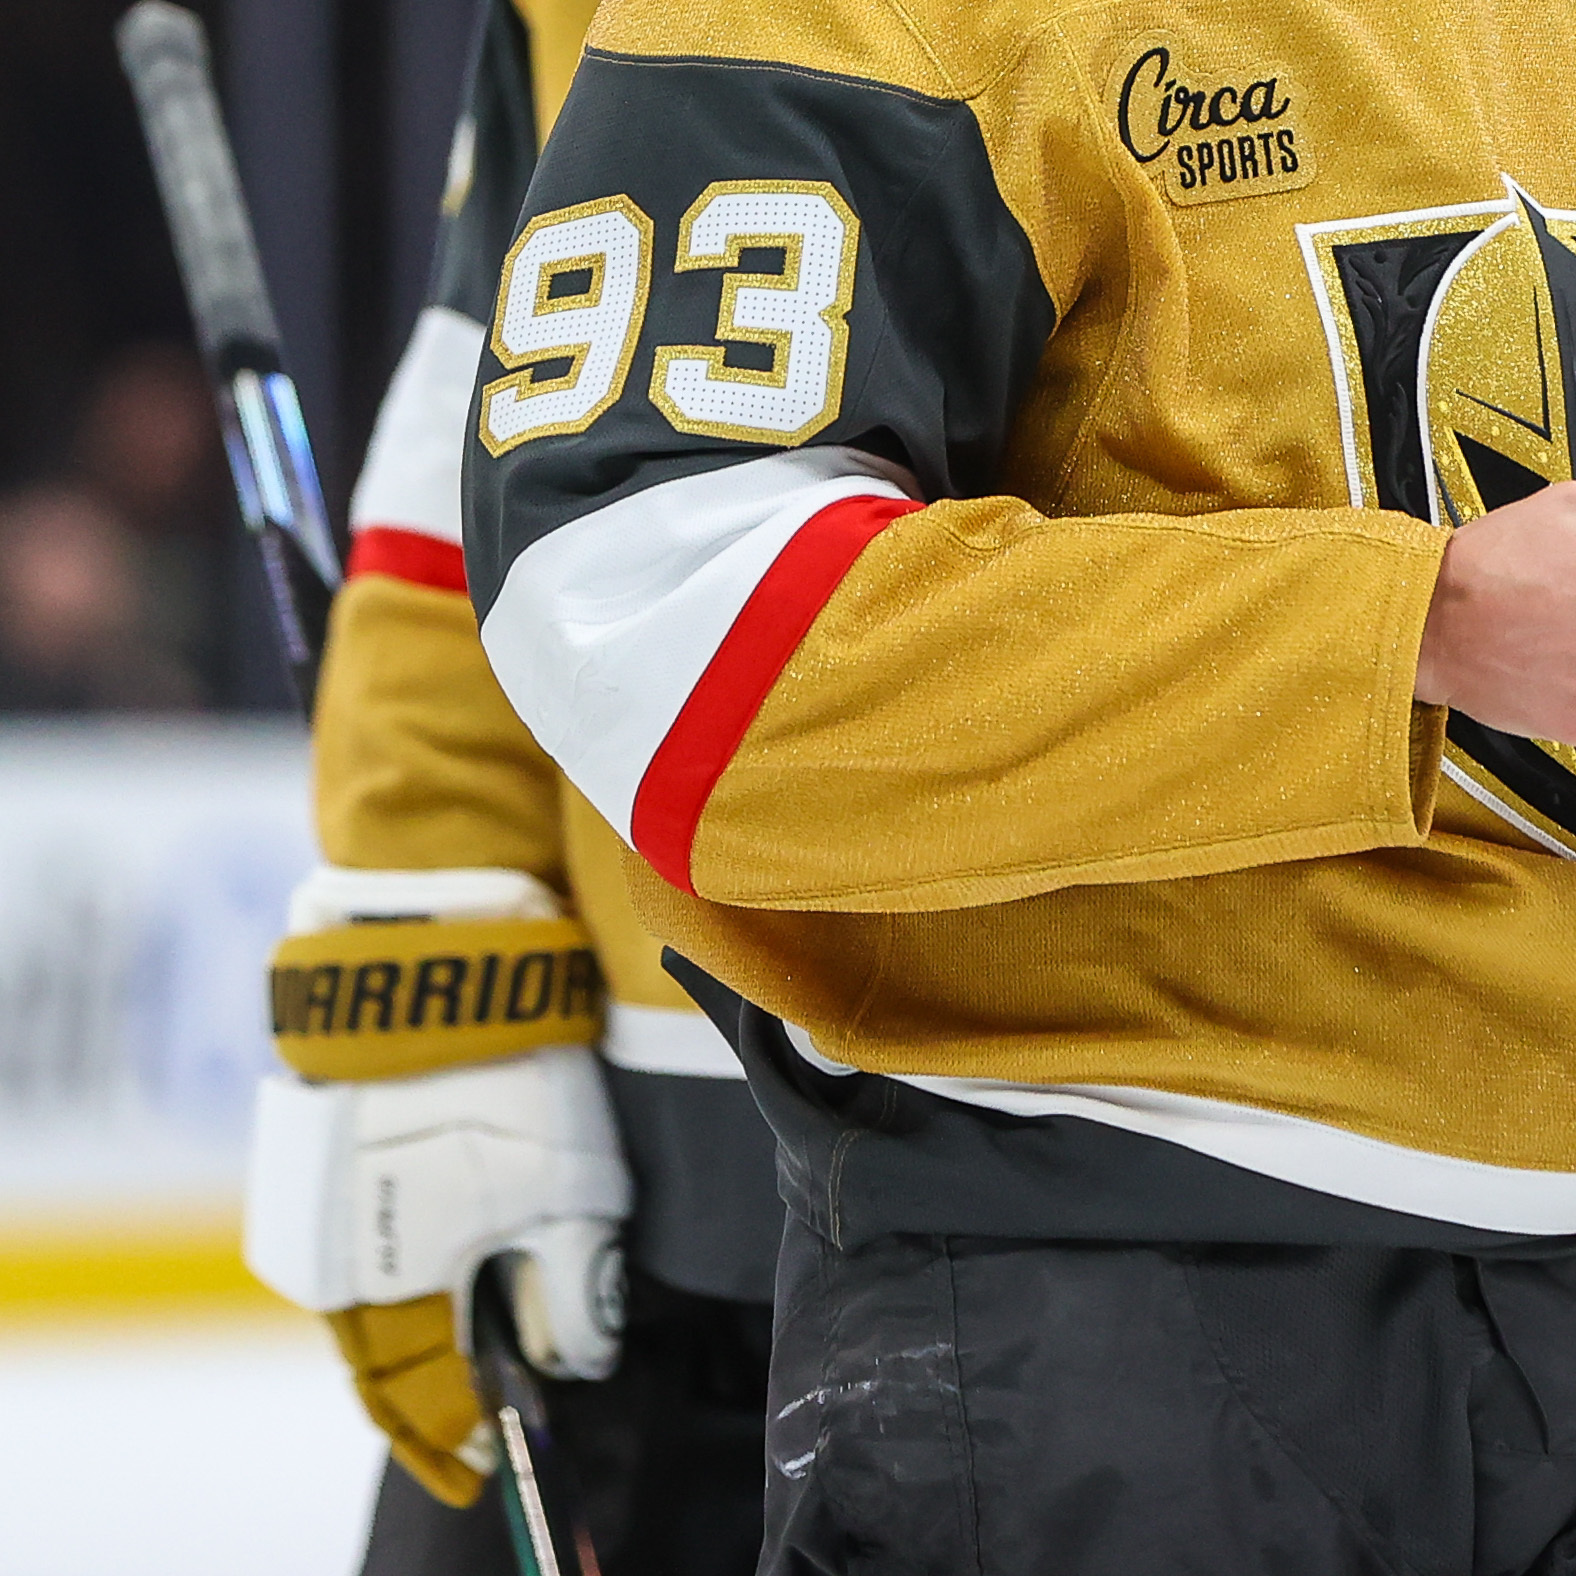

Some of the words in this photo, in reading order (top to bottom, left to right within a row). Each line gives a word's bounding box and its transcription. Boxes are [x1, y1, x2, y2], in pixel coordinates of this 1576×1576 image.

[1117, 46, 1291, 163] Circa
[1177, 129, 1299, 189] SPORTS
[479, 179, 862, 459] 93
